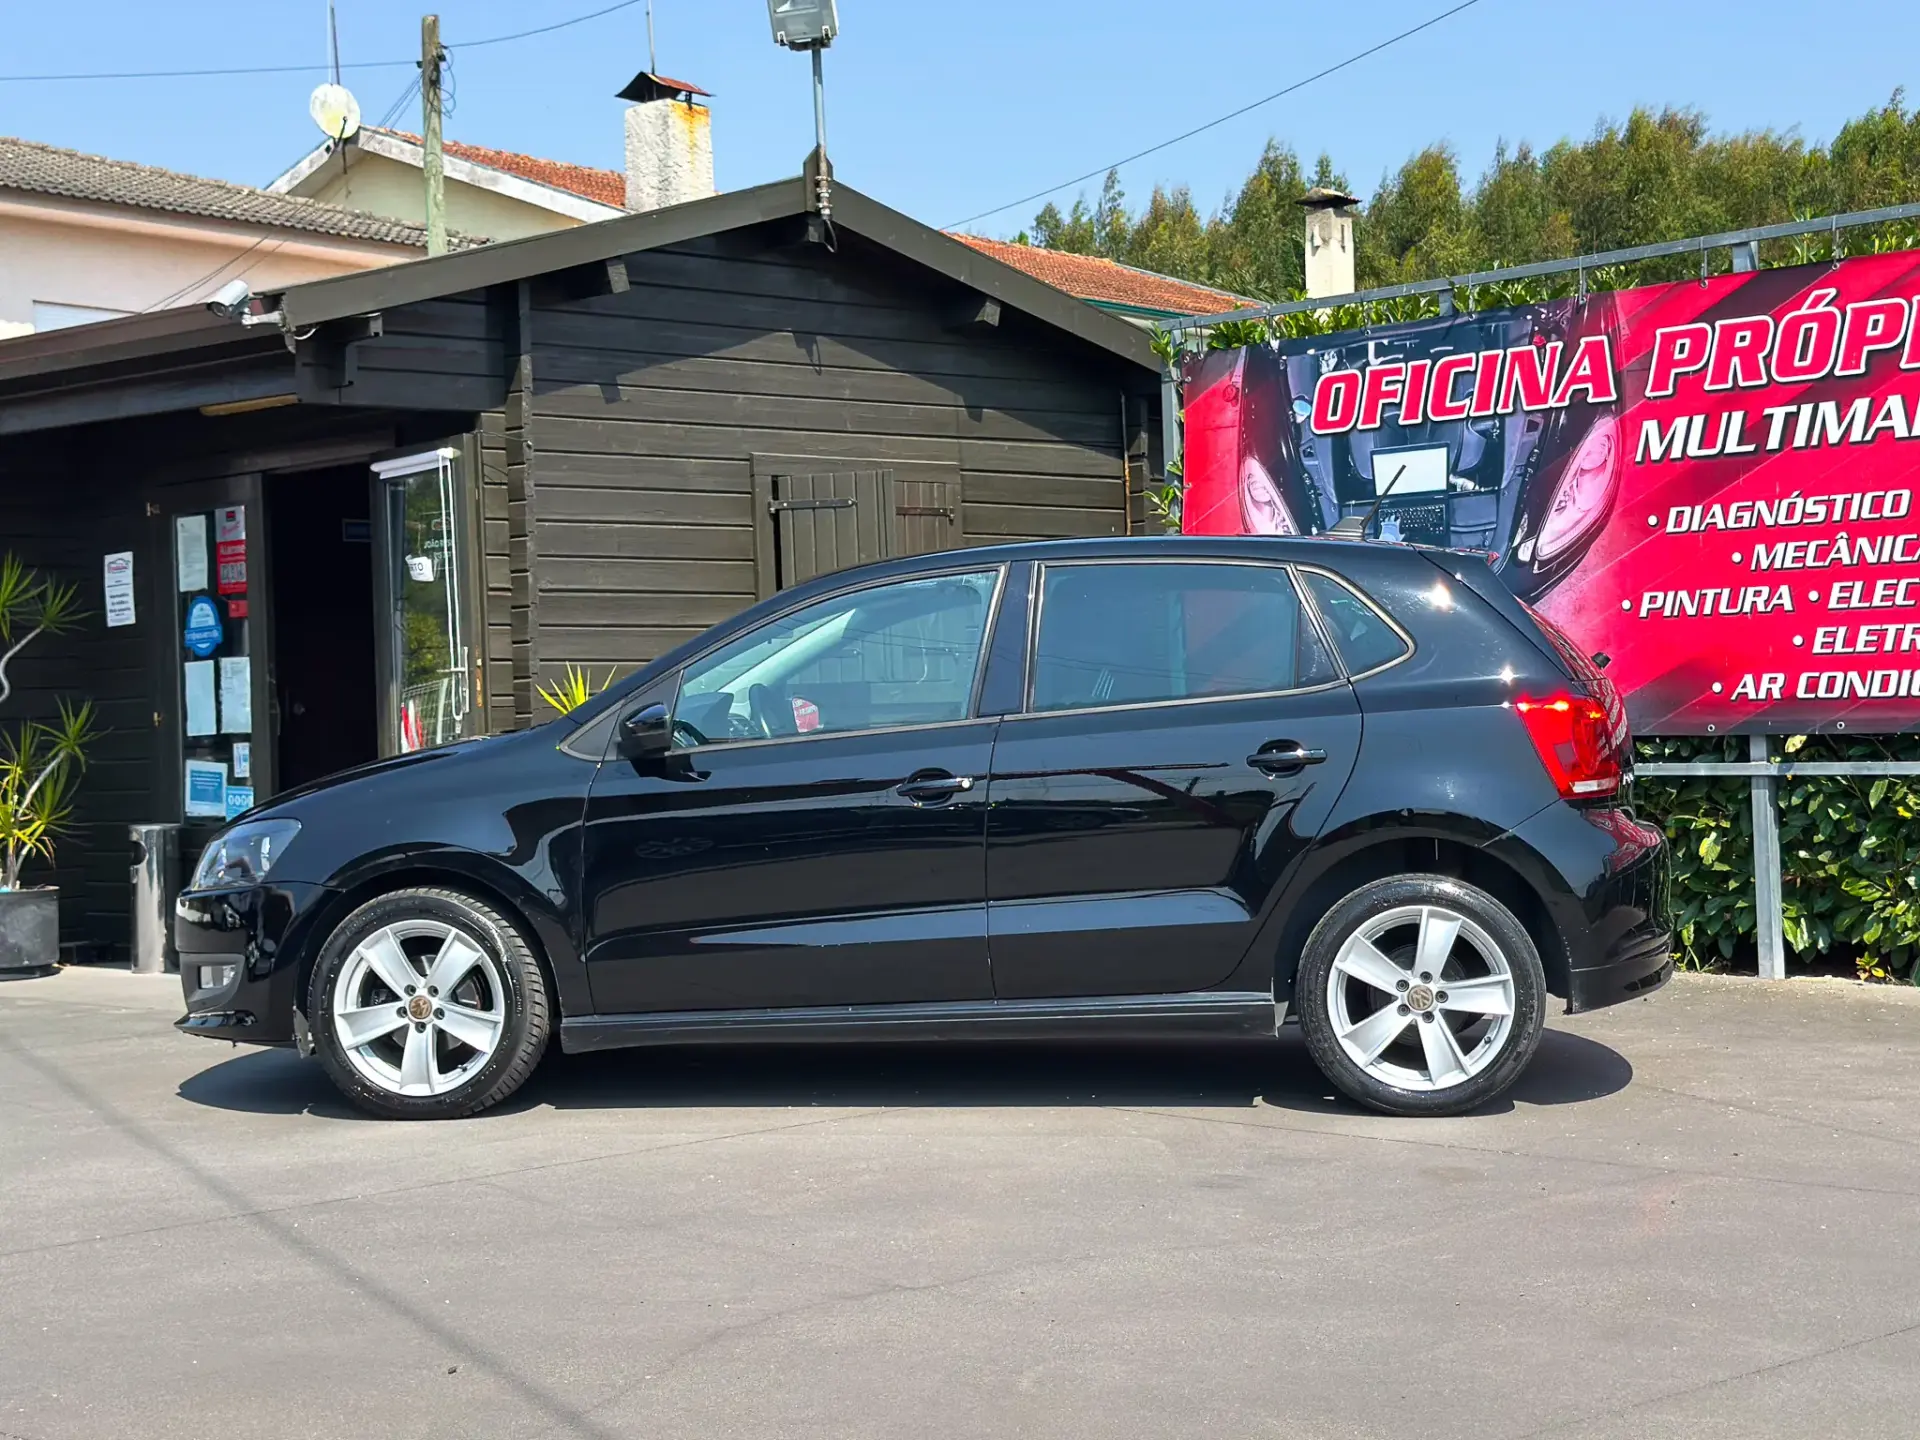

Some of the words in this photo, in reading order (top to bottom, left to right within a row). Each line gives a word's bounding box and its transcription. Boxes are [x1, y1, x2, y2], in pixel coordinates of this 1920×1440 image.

[1310, 336, 1618, 435] OFICINA
[1635, 394, 1920, 462] MULTIMA
[1665, 490, 1911, 533] DIAGNÓSTICO
[1751, 531, 1920, 570] MECÂNIC
[1639, 585, 1793, 617] PINTURA
[1730, 673, 1785, 700] AR
